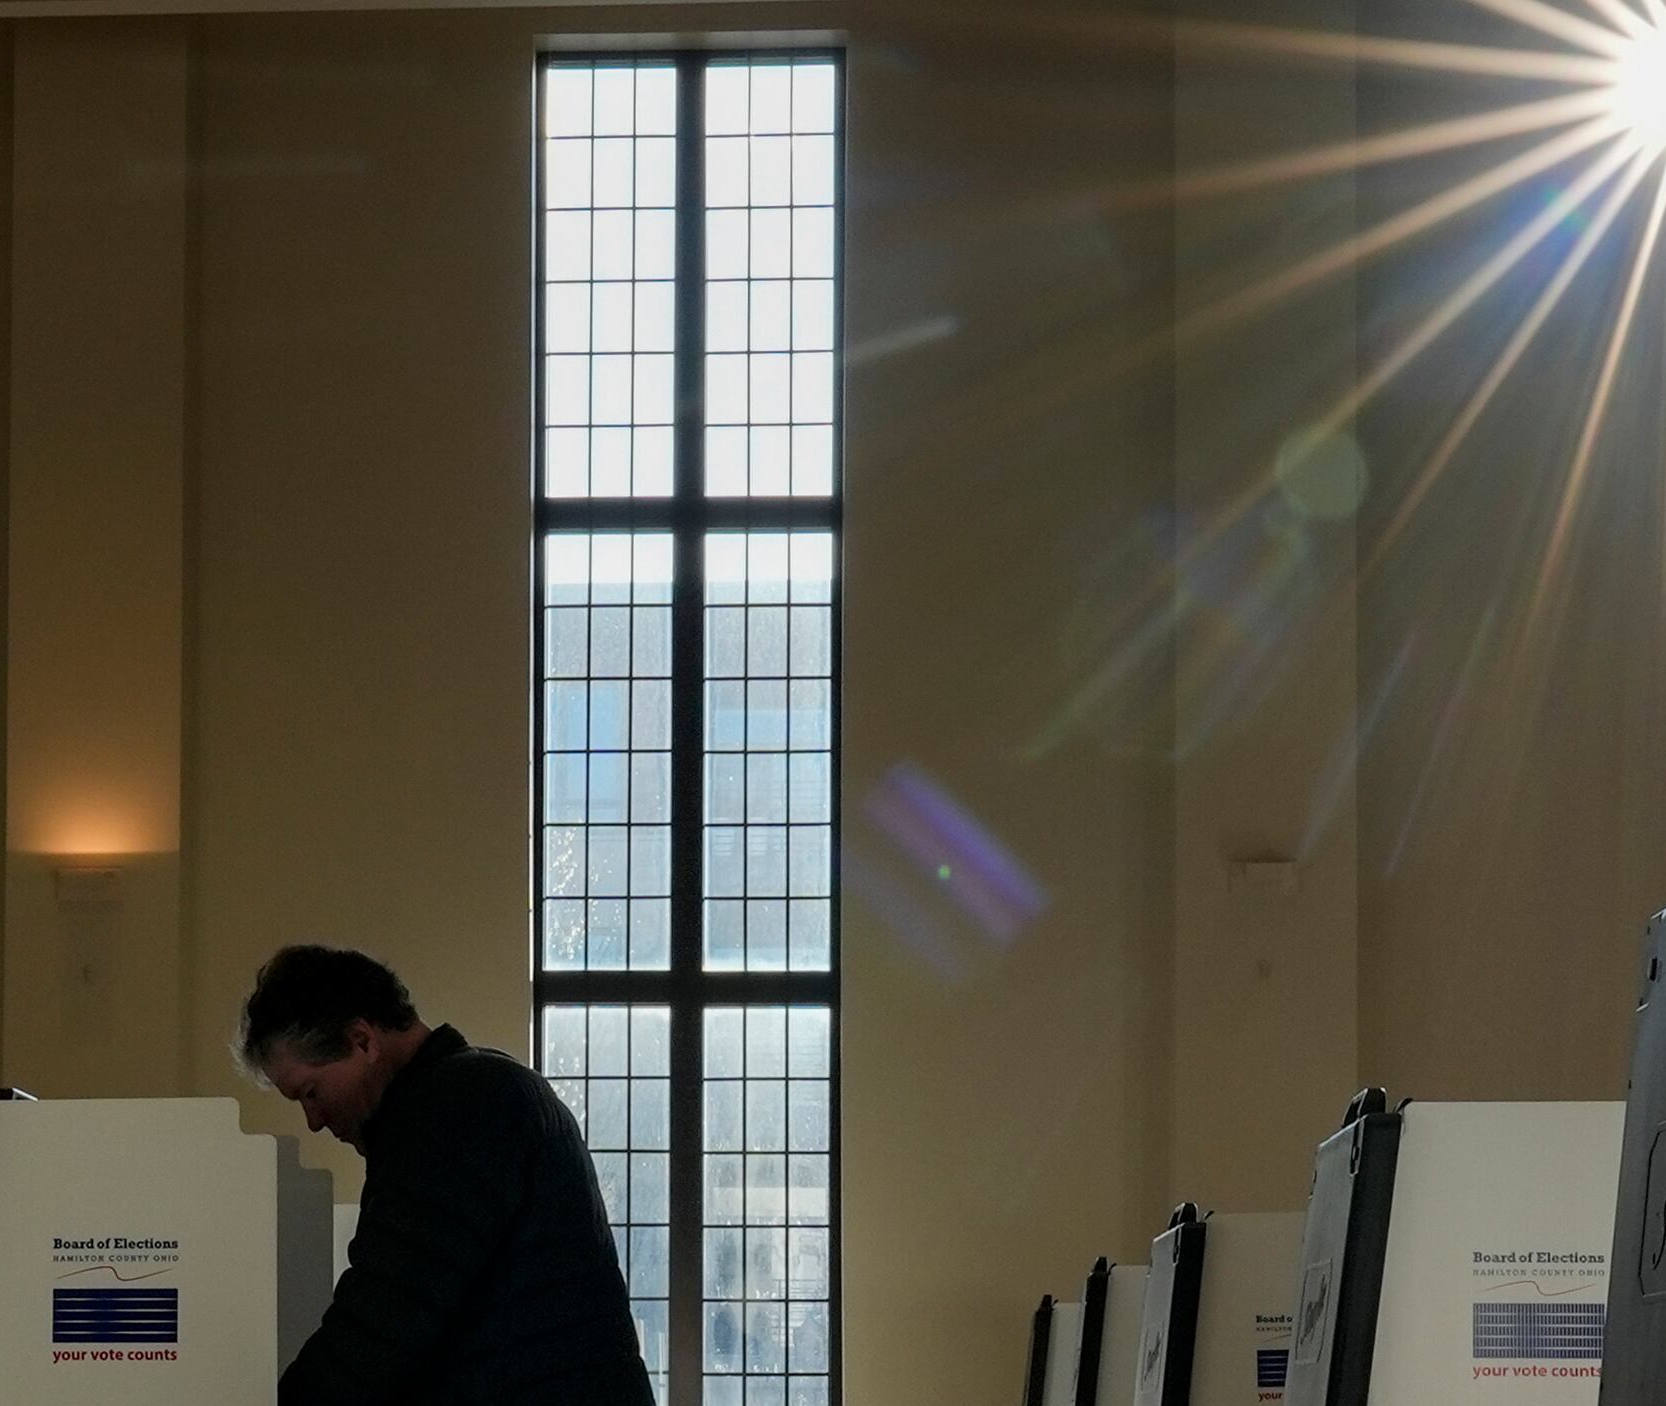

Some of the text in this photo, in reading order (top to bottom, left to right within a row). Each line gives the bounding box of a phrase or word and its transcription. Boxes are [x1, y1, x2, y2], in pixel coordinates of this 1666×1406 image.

[53, 1238, 179, 1249] Board of Elections
[1473, 1252, 1605, 1263] Board of Elections
[1256, 1315, 1285, 1323] Board
[53, 1349, 177, 1364] your vote counts
[1473, 1367, 1509, 1380] your
[1513, 1366, 1548, 1377] vote
[1258, 1392, 1283, 1402] your
